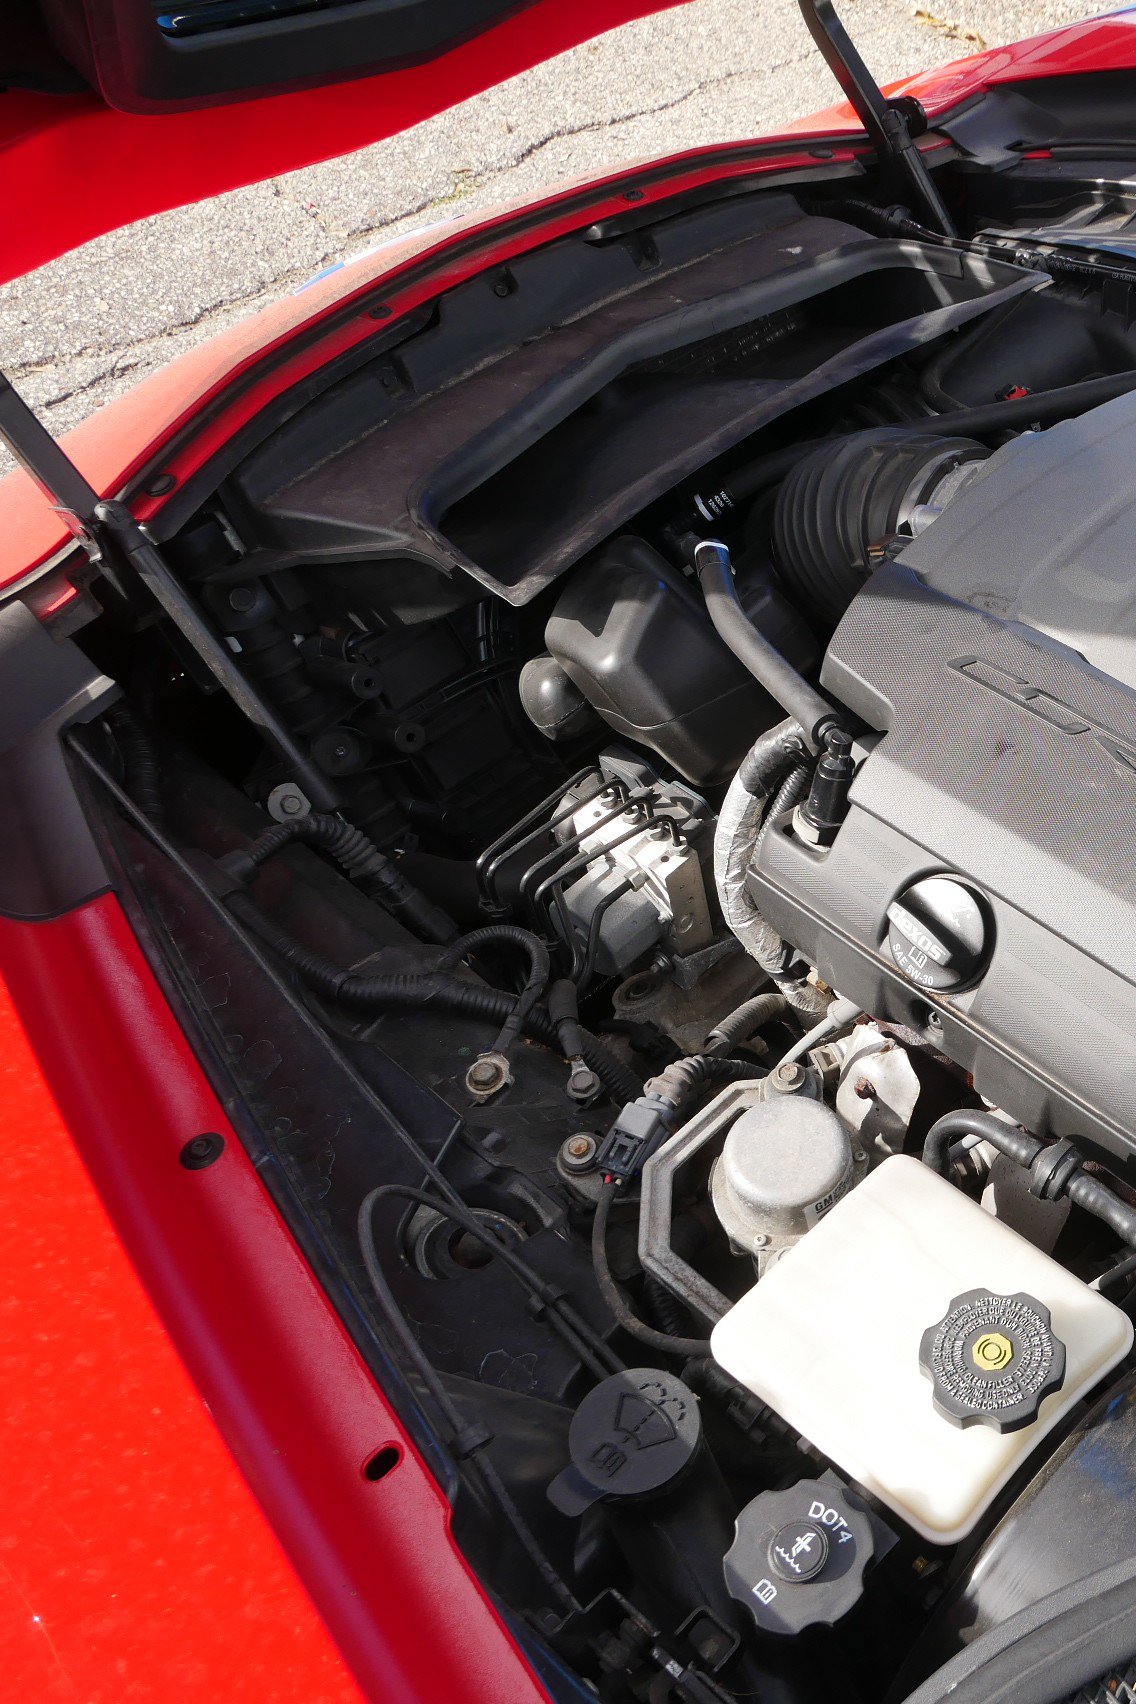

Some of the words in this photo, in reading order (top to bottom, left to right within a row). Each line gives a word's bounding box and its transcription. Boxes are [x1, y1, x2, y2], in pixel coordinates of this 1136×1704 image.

[890, 907, 943, 961] dexos
[892, 943, 907, 967] SAE
[905, 964, 935, 986] 5W-30
[815, 1194, 833, 1214] GM
[963, 1371, 987, 1389] CLEAN
